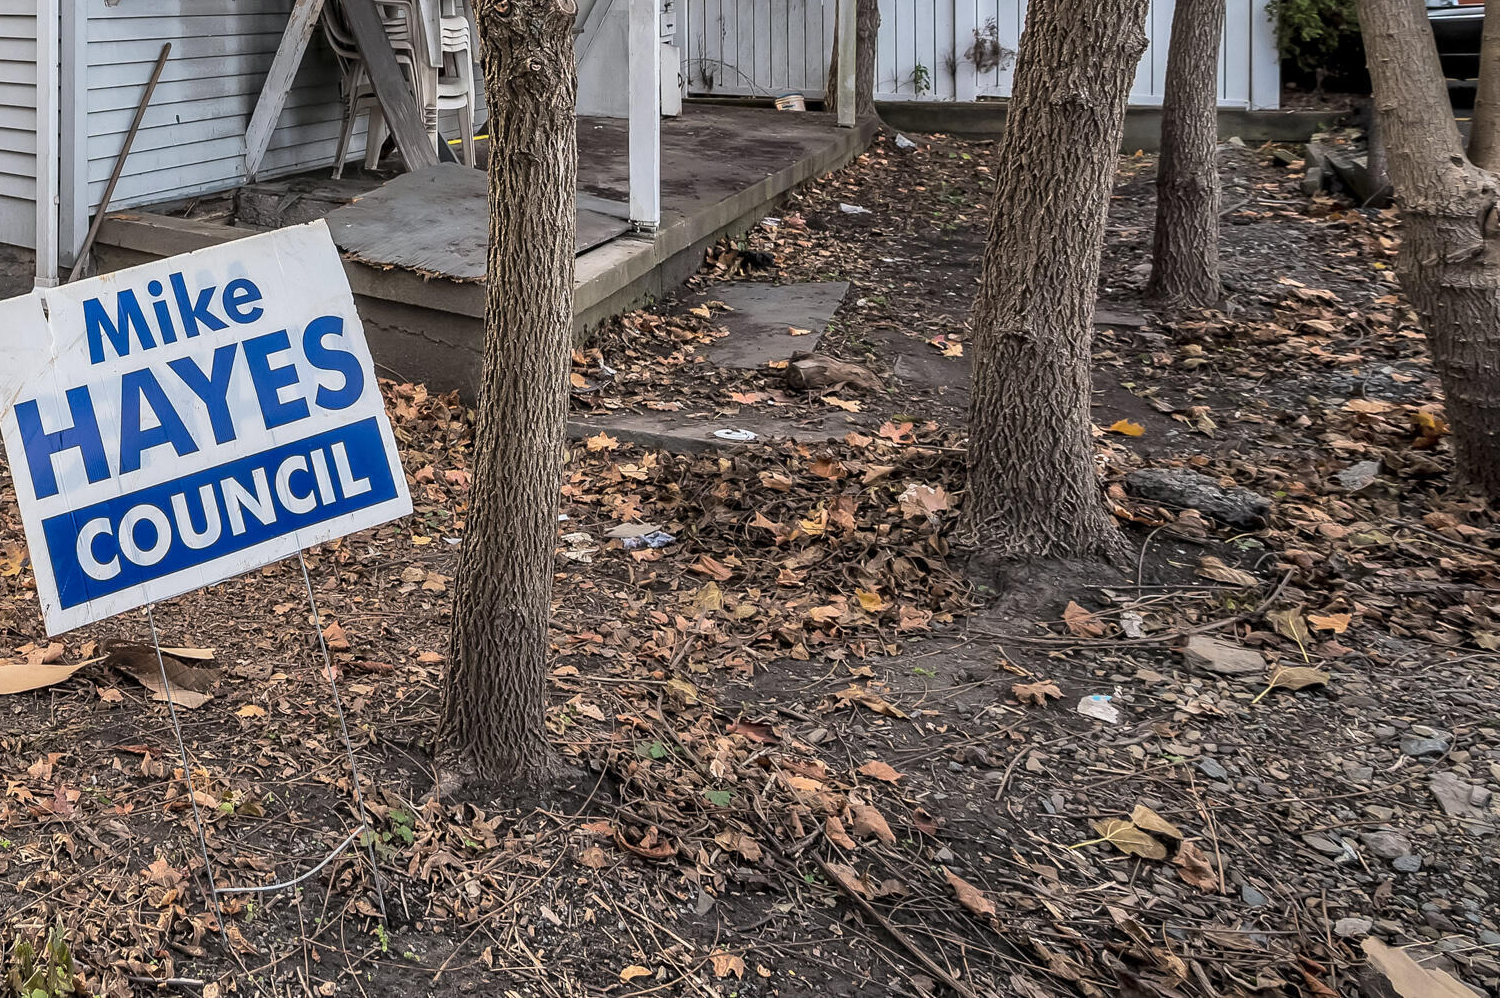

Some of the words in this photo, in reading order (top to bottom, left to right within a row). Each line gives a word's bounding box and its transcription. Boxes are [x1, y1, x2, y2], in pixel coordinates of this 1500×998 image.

[82, 272, 264, 365] Mike
[14, 315, 365, 501] HAYES
[75, 441, 372, 581] COUNCIL
